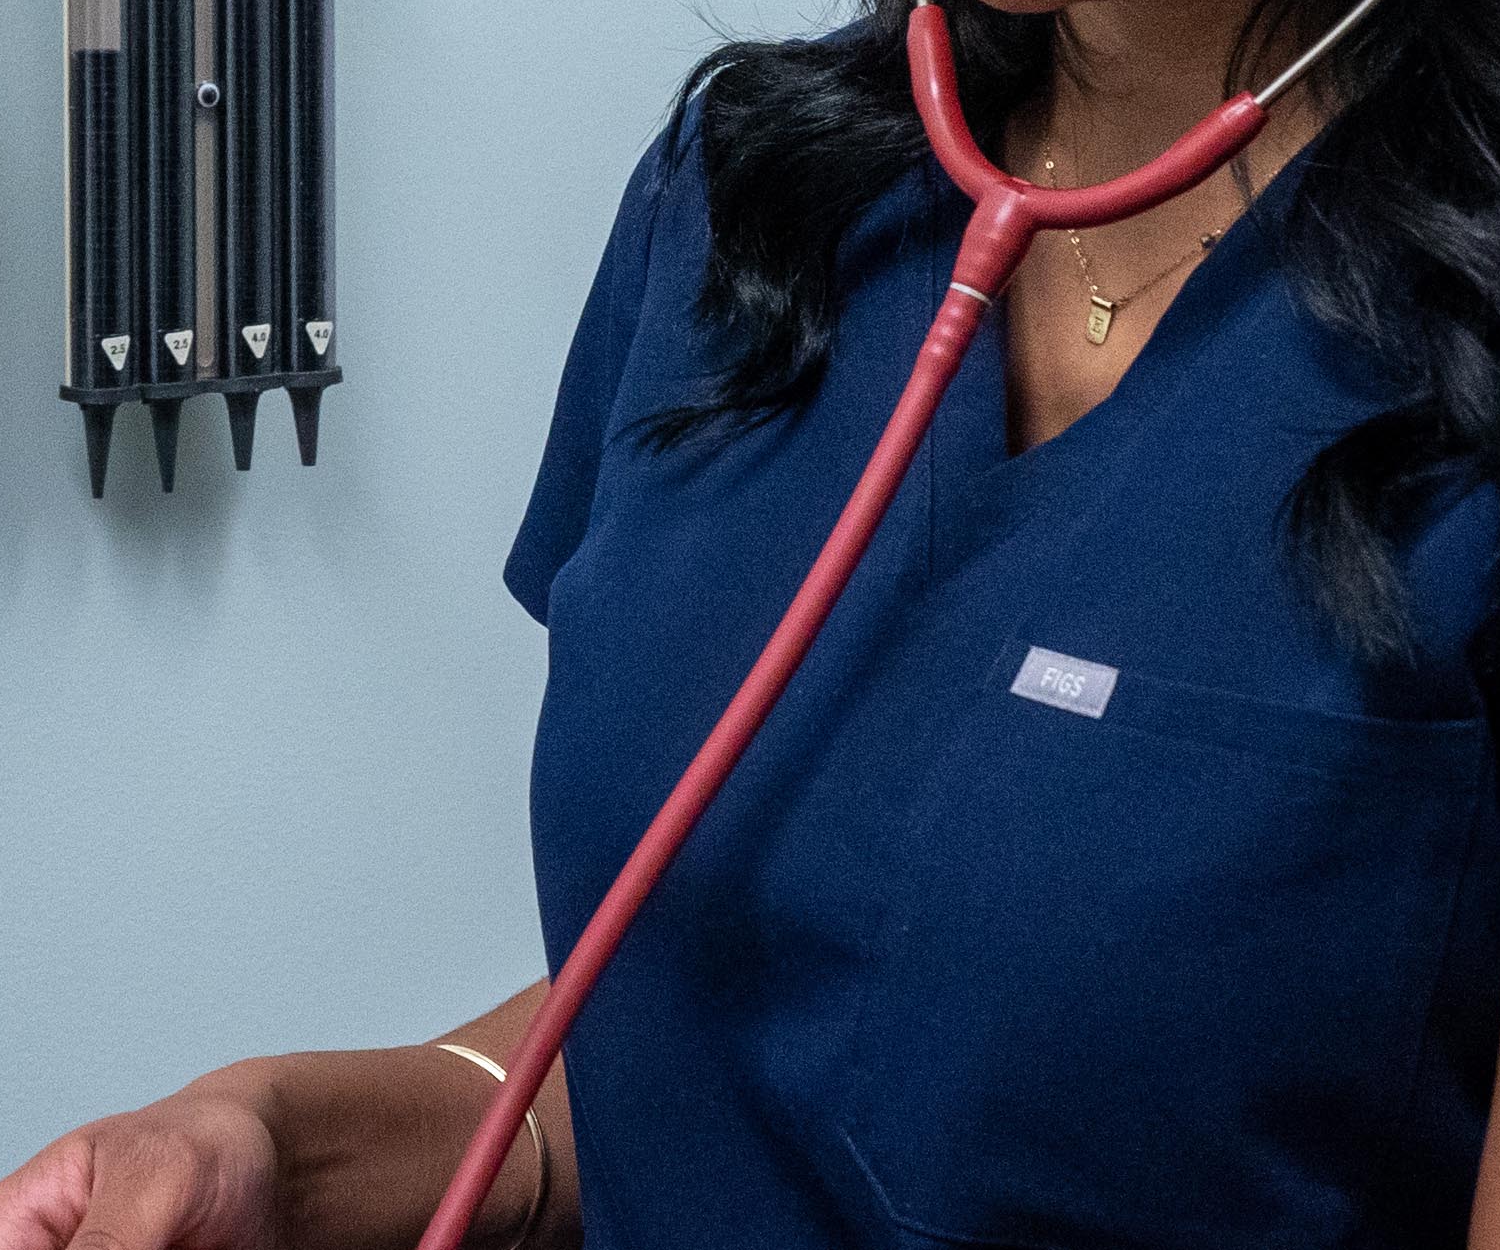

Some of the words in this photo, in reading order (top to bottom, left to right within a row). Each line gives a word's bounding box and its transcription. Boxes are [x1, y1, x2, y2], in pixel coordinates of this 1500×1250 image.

[251, 332, 267, 343] 4.0
[314, 328, 329, 339] 4.0
[110, 343, 127, 356] 2.5
[172, 338, 189, 351] 2.5
[1039, 666, 1087, 699] FIGS
